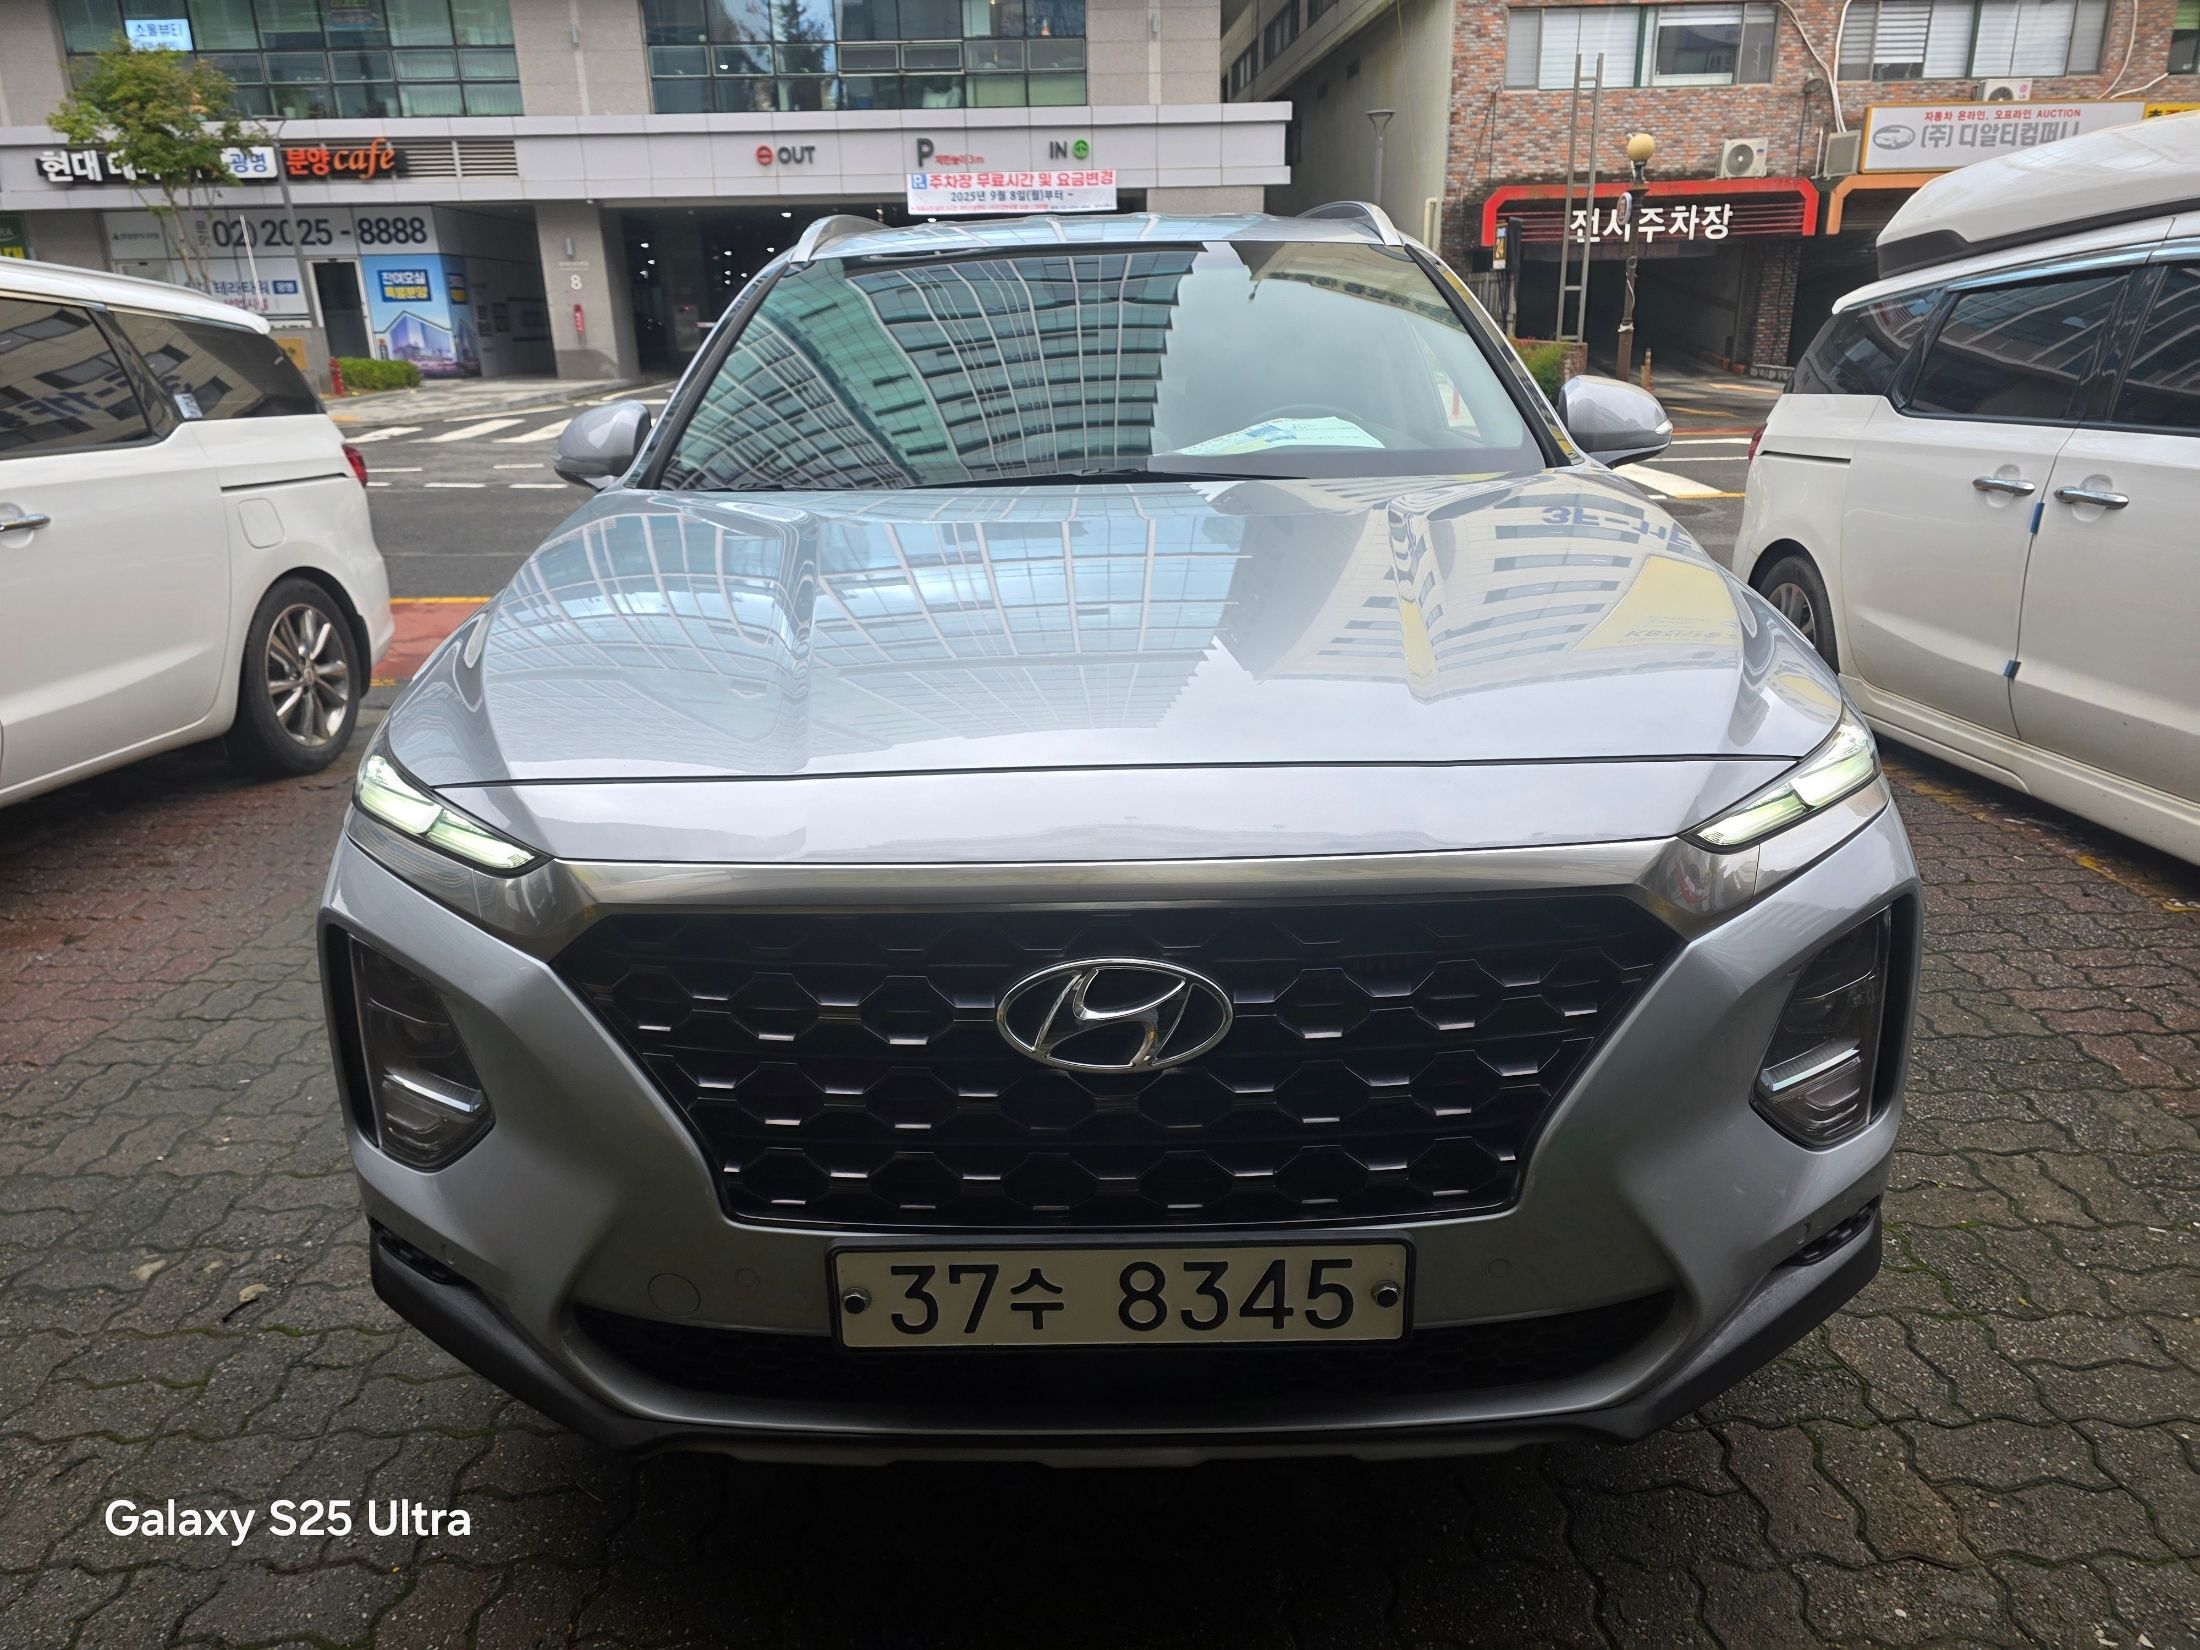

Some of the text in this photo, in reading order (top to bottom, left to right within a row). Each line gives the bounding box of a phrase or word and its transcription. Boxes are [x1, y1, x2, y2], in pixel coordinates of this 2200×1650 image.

[1925, 111, 1953, 122] 자동차
[1994, 109, 2032, 120] 오프라인
[2037, 108, 2081, 119] AUCTION
[1921, 124, 1953, 149] (주)
[778, 146, 816, 164] OUT
[917, 137, 935, 168] P
[1049, 141, 1068, 159] IN
[41, 149, 103, 182] 현대
[286, 147, 330, 176] 분양
[929, 174, 972, 189] 주차장
[977, 173, 1034, 188] 무료시간
[1039, 173, 1052, 187] 및
[1057, 170, 1113, 187] 요금변경
[951, 190, 986, 202] 2025년
[990, 189, 1006, 201] 9월
[357, 217, 427, 245] 8888
[570, 274, 583, 290] 8
[889, 1258, 1355, 1335] 37수 8345
